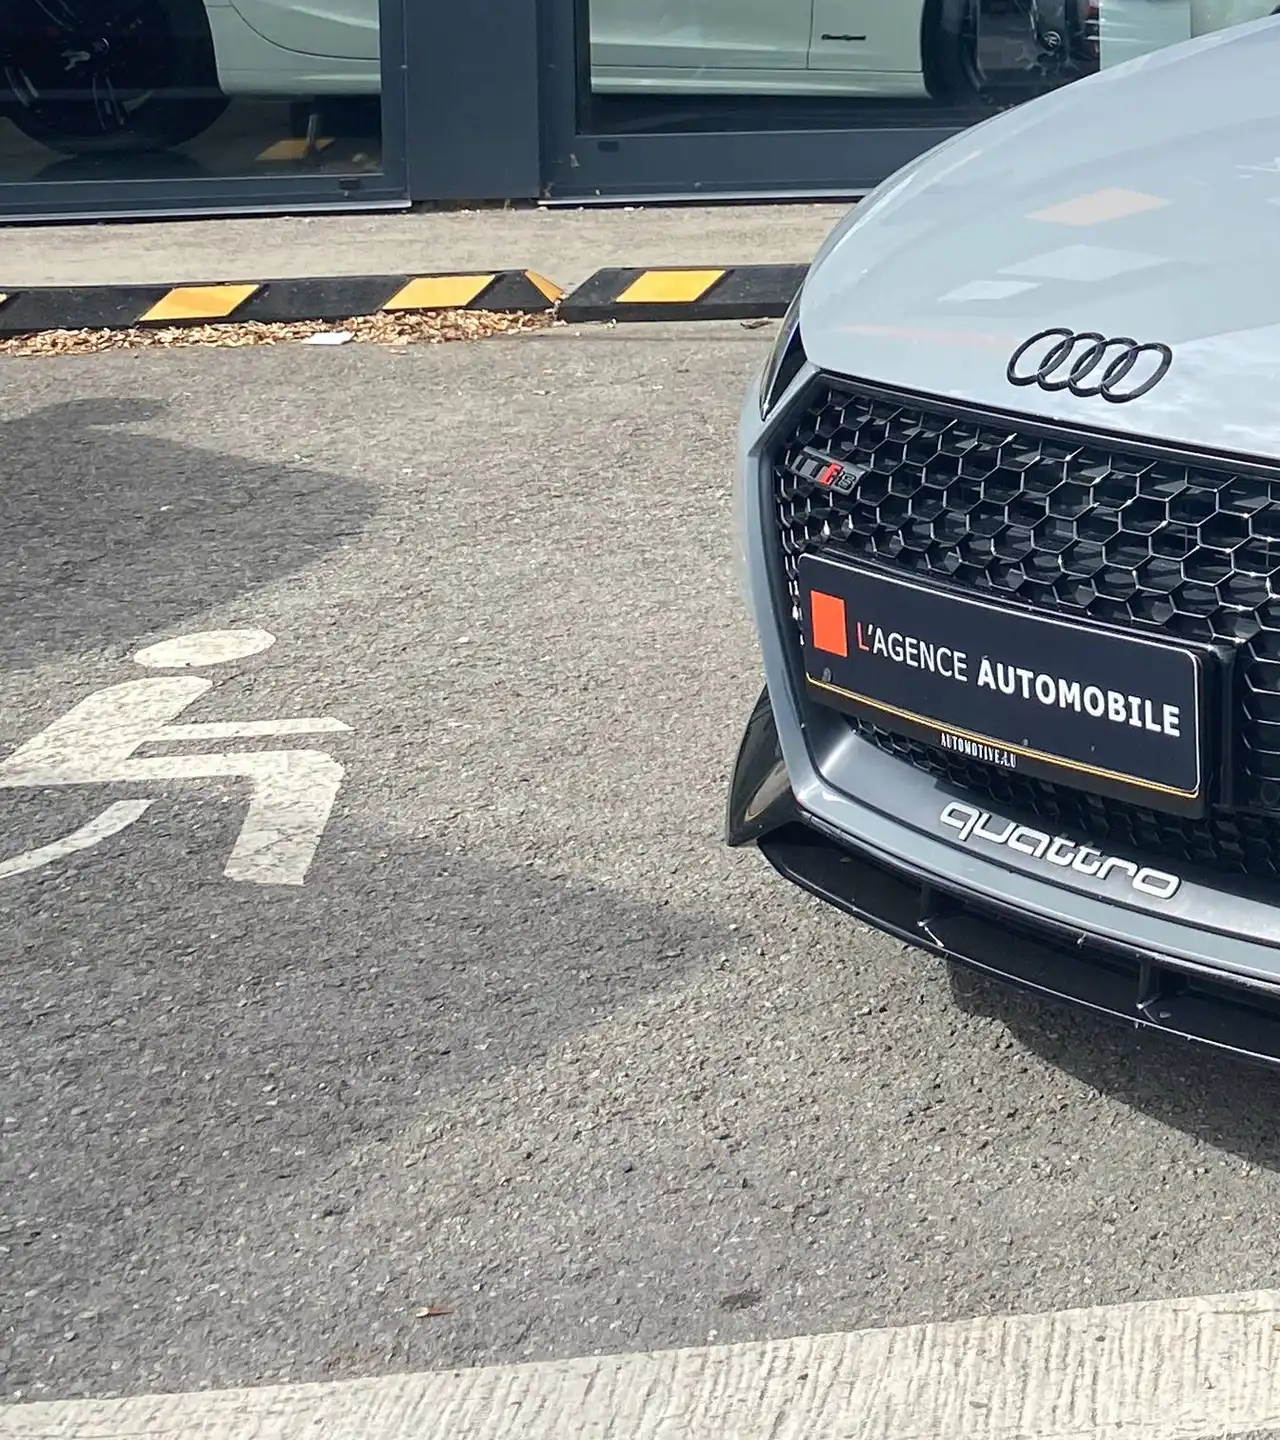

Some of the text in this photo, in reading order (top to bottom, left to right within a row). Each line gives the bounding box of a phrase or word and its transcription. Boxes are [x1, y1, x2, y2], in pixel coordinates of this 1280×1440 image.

[856, 621, 1182, 738] L'AGENCE AUTOMOBILE
[938, 800, 1182, 901] quattro
